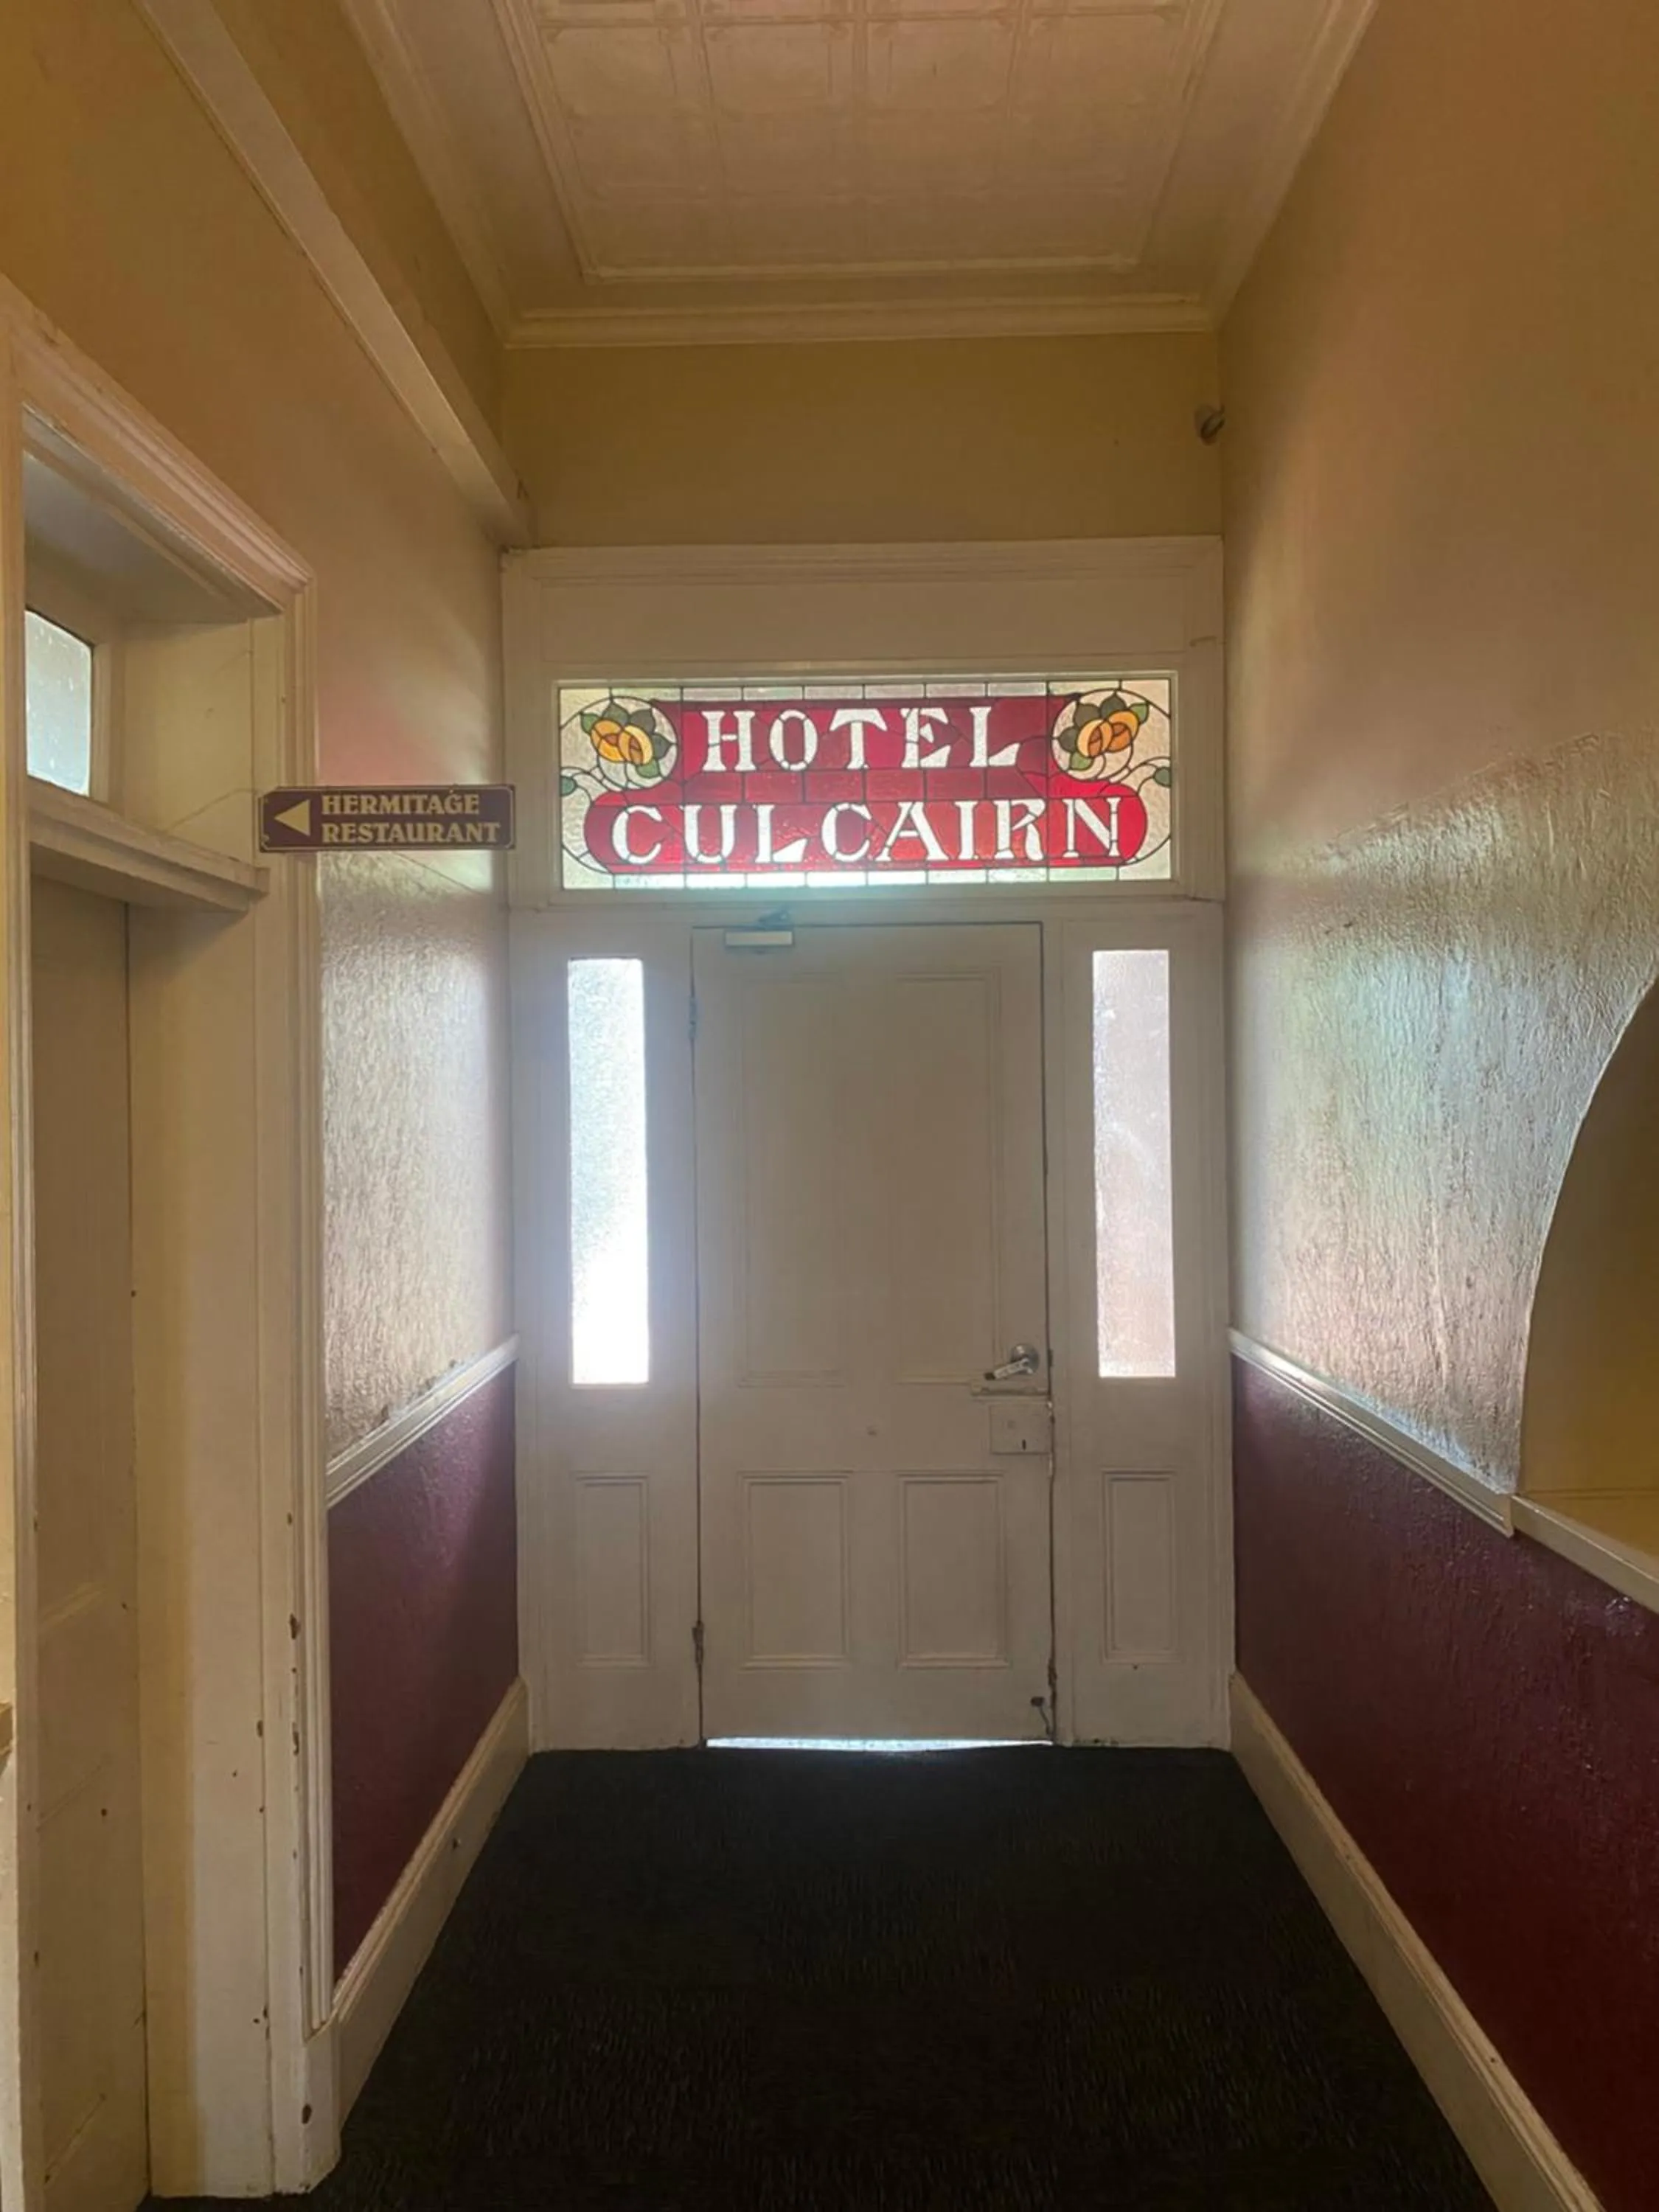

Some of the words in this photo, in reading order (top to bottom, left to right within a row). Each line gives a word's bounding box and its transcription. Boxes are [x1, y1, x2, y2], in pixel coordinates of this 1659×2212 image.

[701, 706, 1020, 773] HOTEL
[321, 793, 479, 815] HERMITAGE
[321, 822, 501, 843] RESTAURANT
[611, 797, 1120, 865] CULCAIRN
